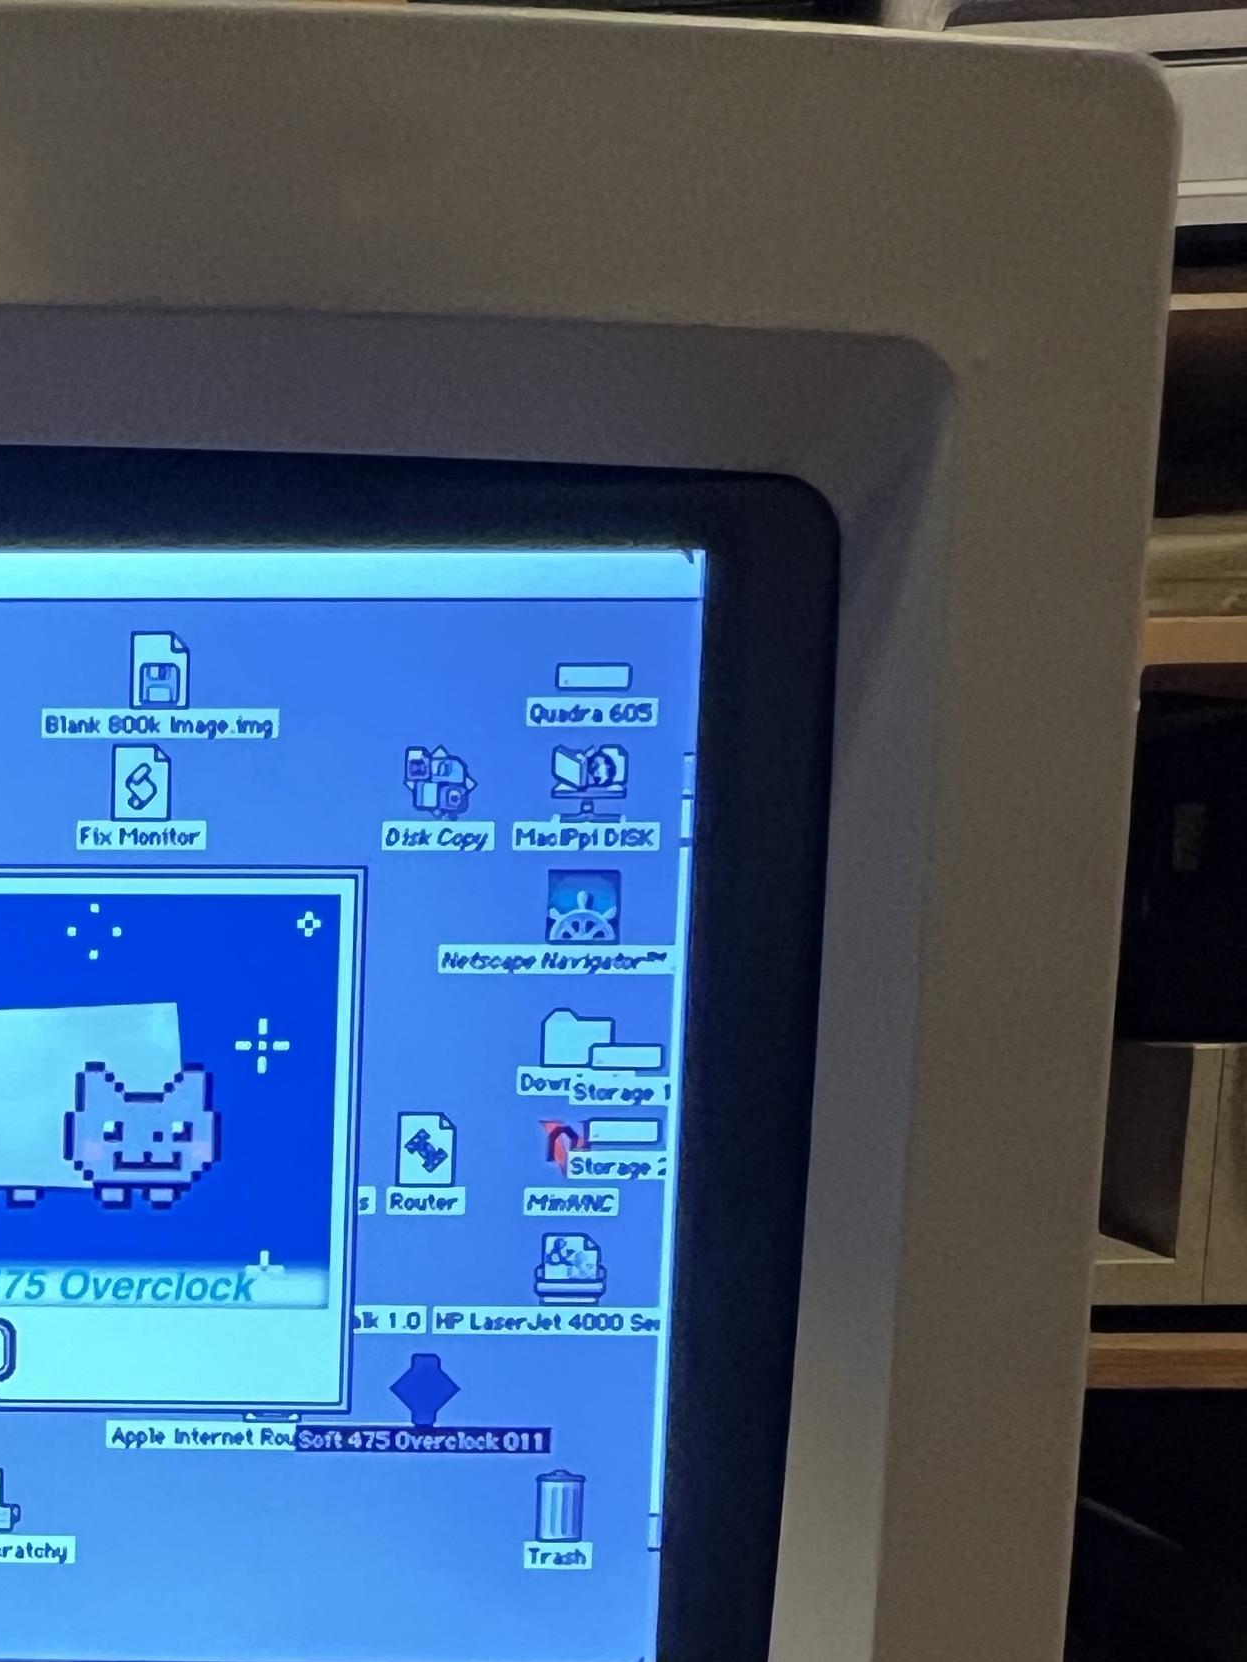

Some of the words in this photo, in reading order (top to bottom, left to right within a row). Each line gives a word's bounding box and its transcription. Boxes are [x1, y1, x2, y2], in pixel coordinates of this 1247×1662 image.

[529, 701, 603, 726] Quadra
[610, 702, 653, 723] 605
[45, 715, 100, 734] Blank
[108, 715, 161, 734] 800k
[170, 715, 274, 739] Image.img
[79, 827, 111, 848] Fix
[118, 827, 200, 848] Monitor
[385, 828, 430, 848] Disk
[437, 828, 489, 851] Copy
[604, 829, 655, 848] DISK
[441, 951, 537, 974] Netscape
[573, 1082, 654, 1105] Storage
[569, 1156, 651, 1181] Storage
[390, 1192, 458, 1211] Router
[59, 1271, 256, 1304] Overclock
[389, 1312, 421, 1330] 1.0
[436, 1312, 464, 1330] HP
[568, 1313, 624, 1332] 4000
[111, 1426, 166, 1449] Apple
[174, 1427, 254, 1446] Internet
[298, 1430, 343, 1450] Soft
[348, 1431, 391, 1450] 475
[395, 1431, 499, 1450] Overclock
[528, 1548, 587, 1566] Trash
